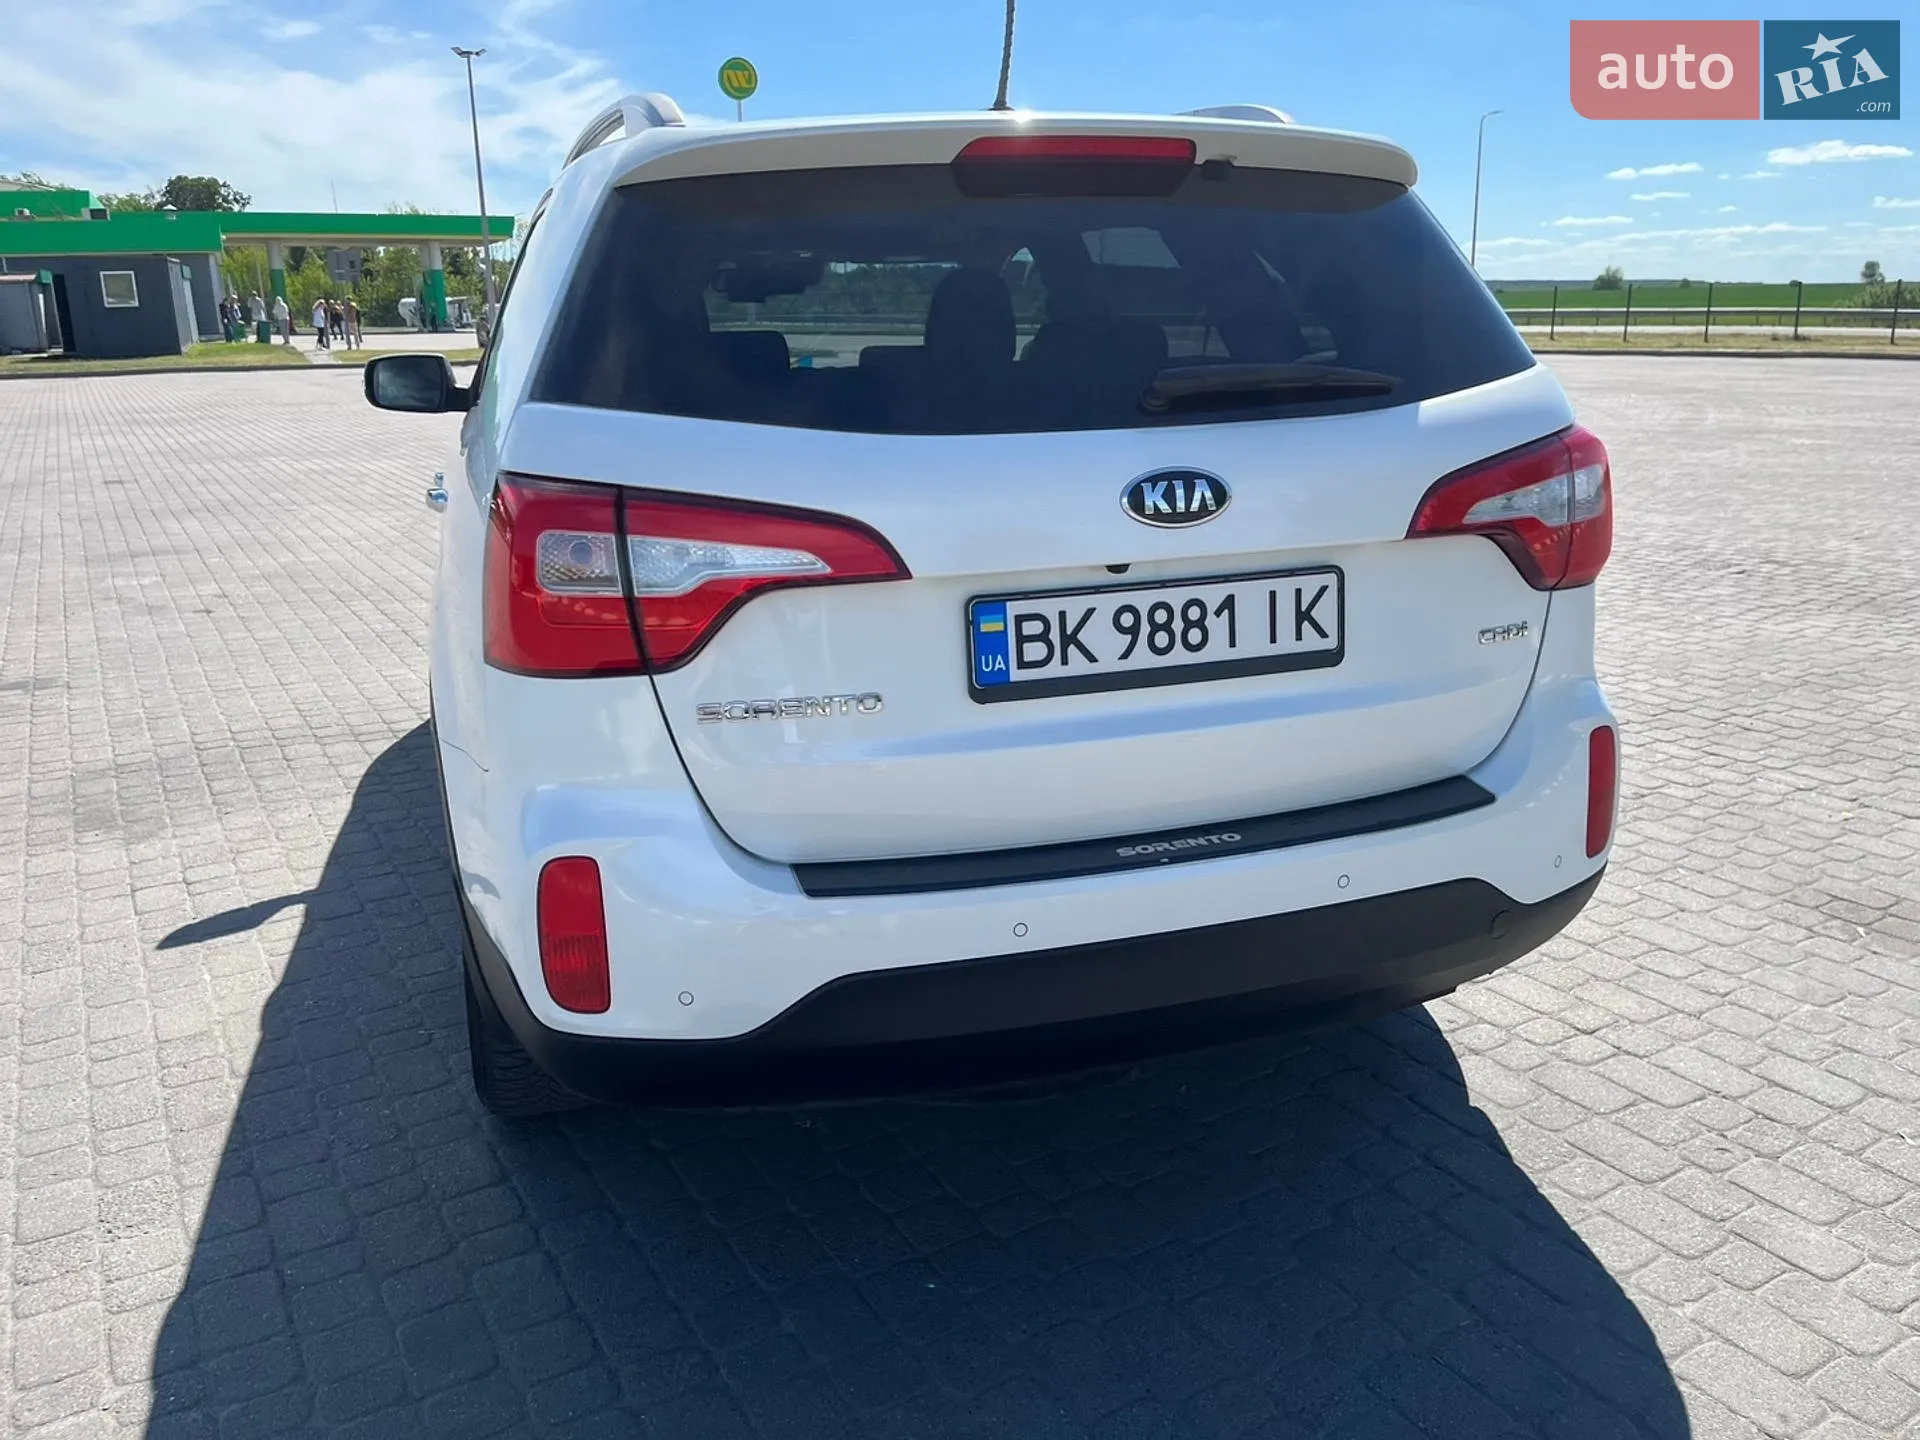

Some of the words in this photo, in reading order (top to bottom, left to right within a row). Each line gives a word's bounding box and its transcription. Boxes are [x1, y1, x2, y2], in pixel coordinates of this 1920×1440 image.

[1140, 478, 1217, 515] KIA
[1014, 607, 1099, 671] BK
[1112, 594, 1236, 661] 9881
[1269, 585, 1330, 645] IK
[981, 655, 1006, 672] UA
[696, 692, 883, 724] SORENTO
[1116, 832, 1242, 857] SORENTO
